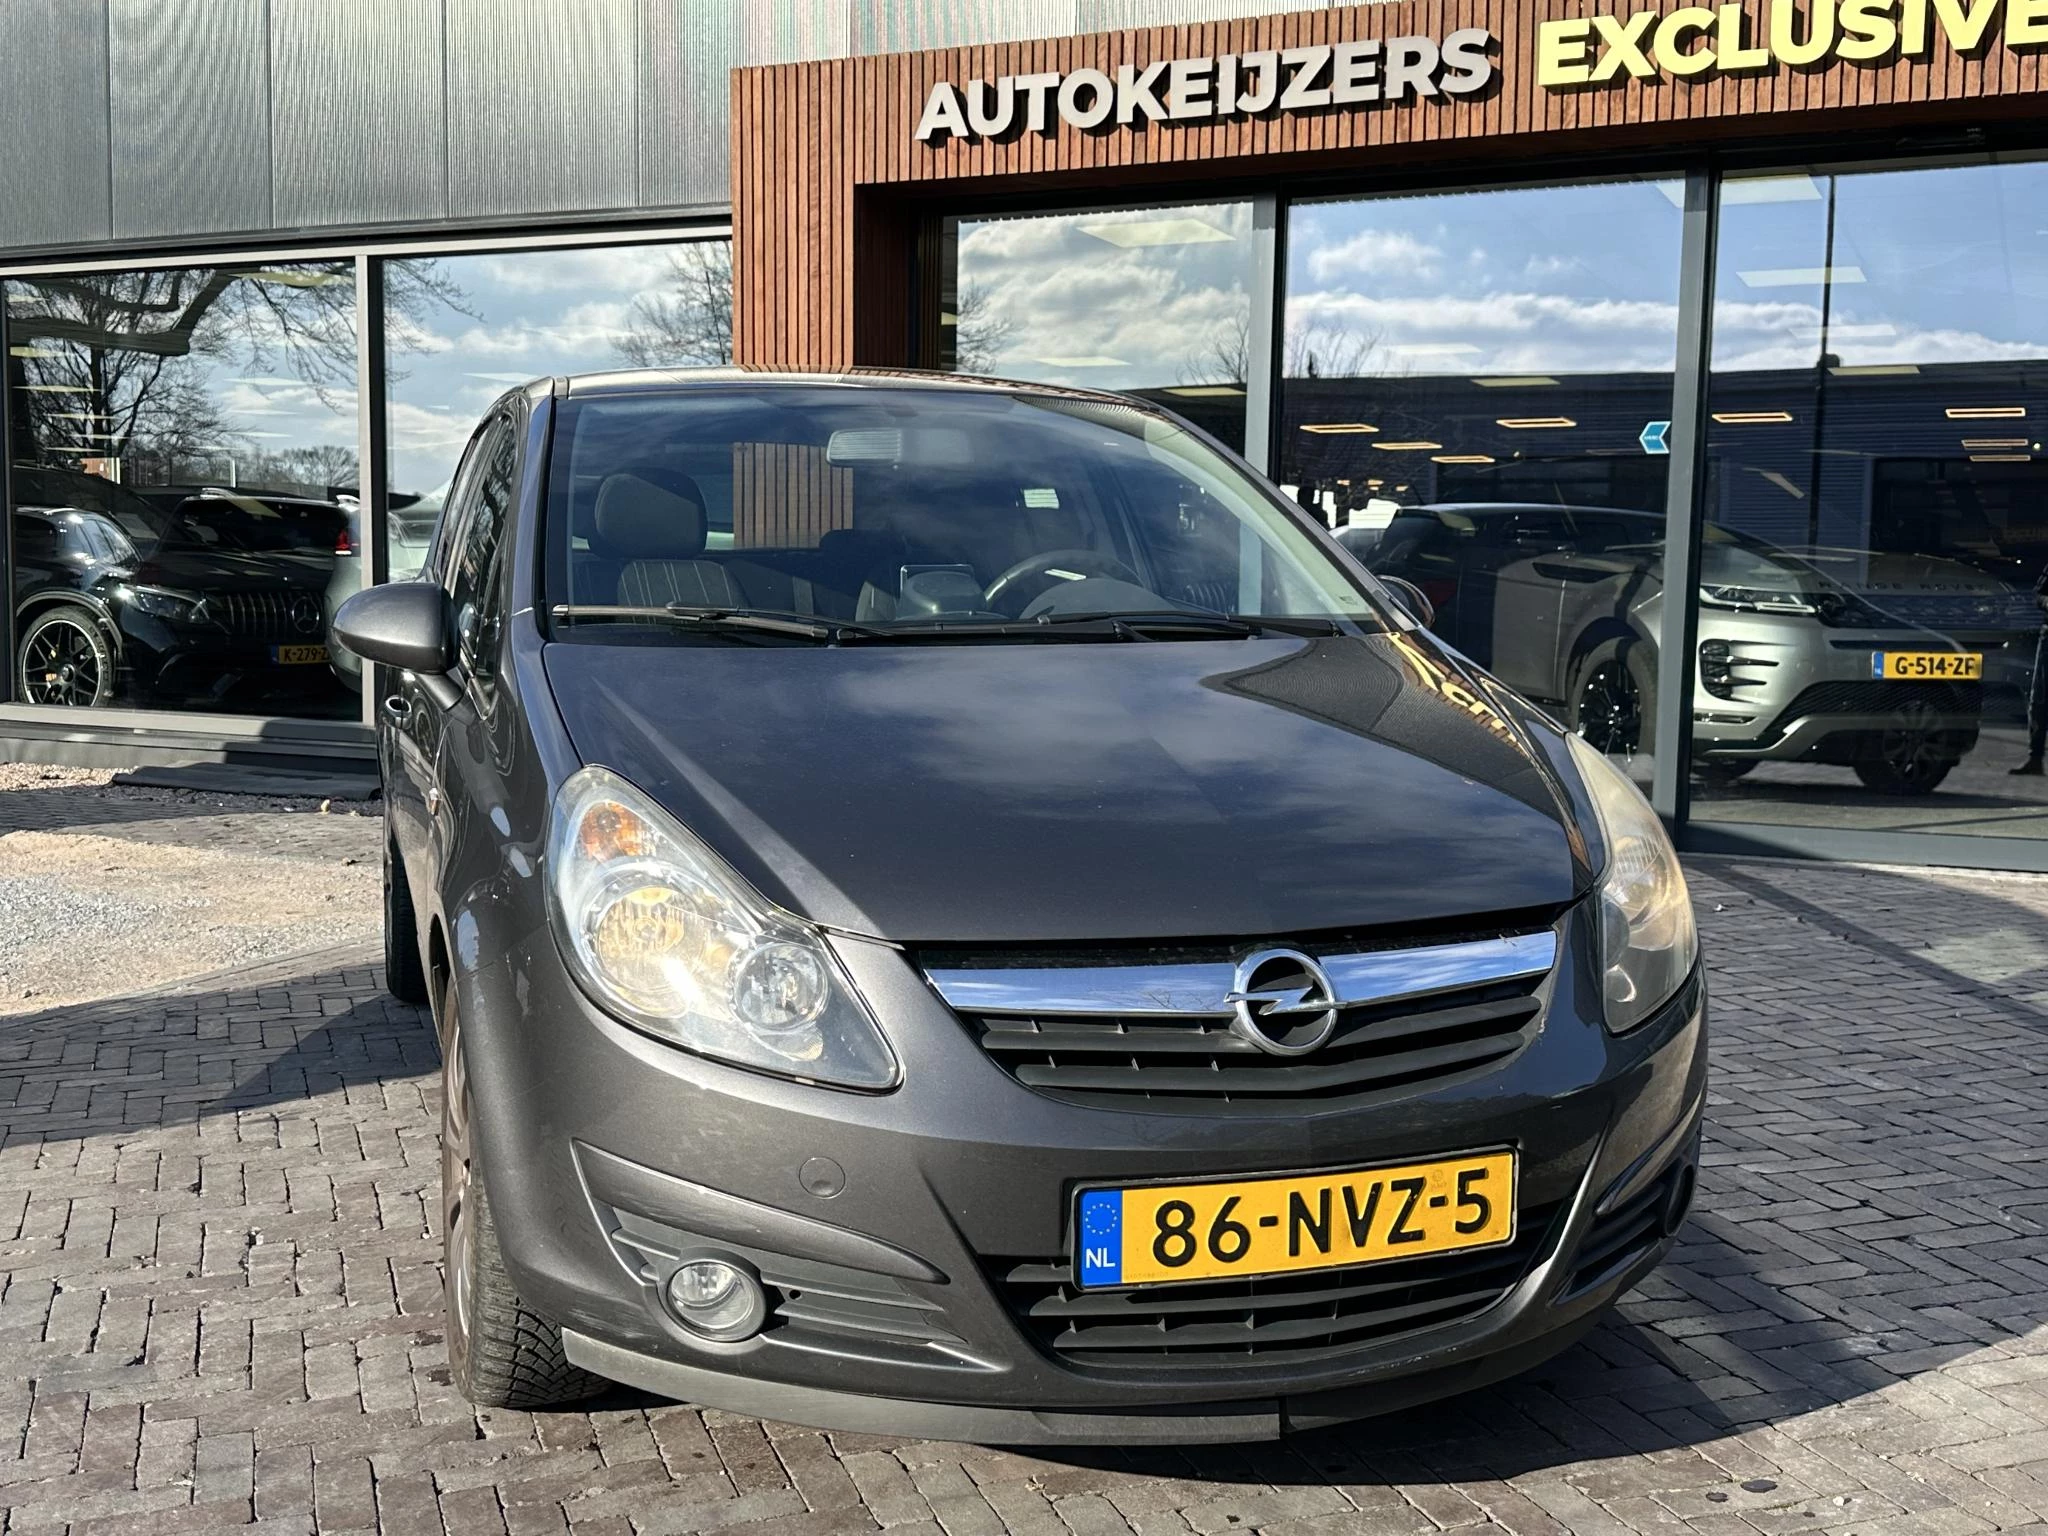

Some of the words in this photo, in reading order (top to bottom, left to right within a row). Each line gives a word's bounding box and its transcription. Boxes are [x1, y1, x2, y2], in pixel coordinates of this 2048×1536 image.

[915, 28, 1494, 141] AUTOKEIJZERS
[284, 647, 329, 662] K-279-Z
[1895, 656, 1976, 675] G-514-ZF
[1152, 1167, 1490, 1268] 86-NVZ-5
[1085, 1247, 1116, 1269] NL
